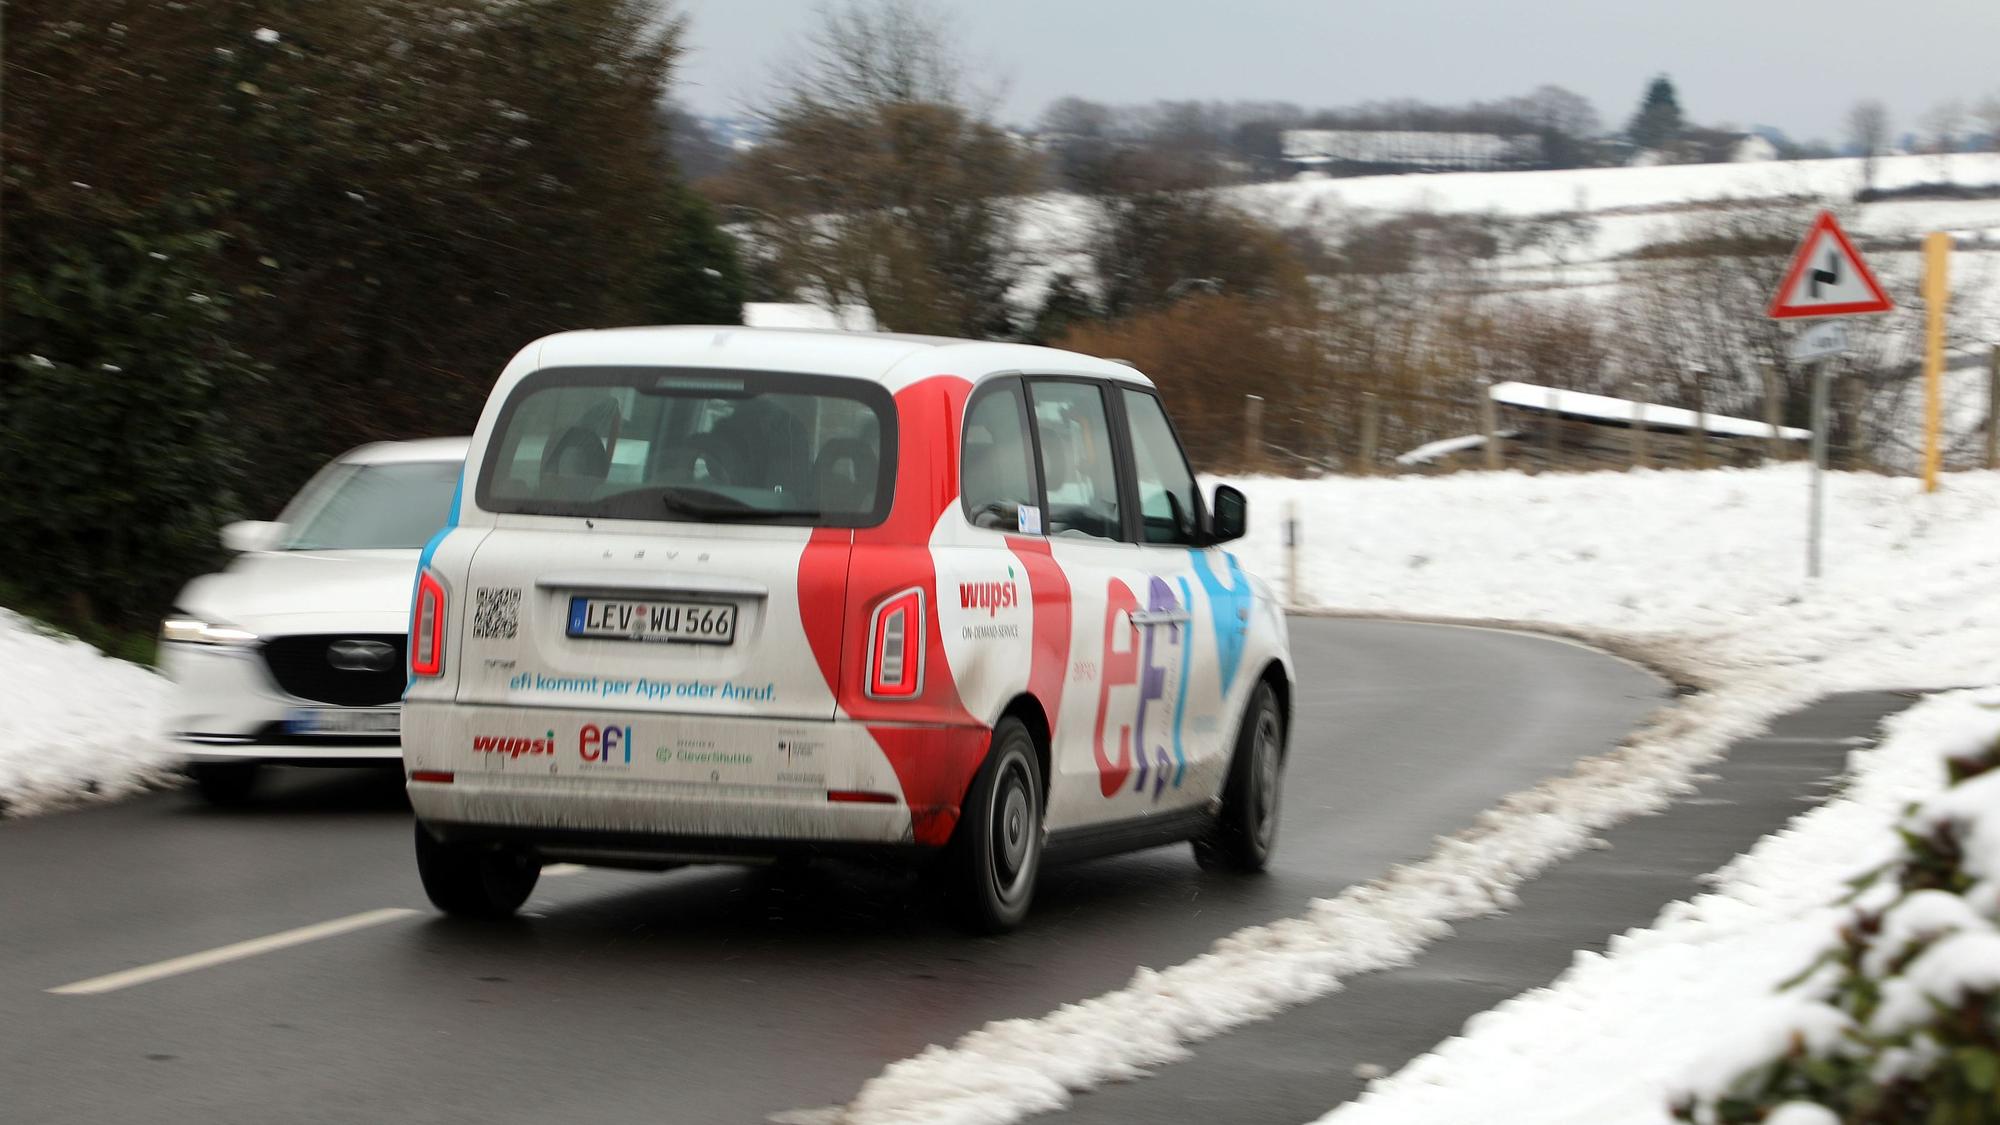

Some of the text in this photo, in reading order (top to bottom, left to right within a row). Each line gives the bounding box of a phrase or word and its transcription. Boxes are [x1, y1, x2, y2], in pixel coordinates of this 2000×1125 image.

[959, 565, 1018, 618] wupsi
[587, 604, 633, 631] LEV
[651, 606, 681, 633] WU
[685, 608, 729, 635] 566
[510, 672, 776, 702] efi kommt per App oder Anruf.
[473, 729, 555, 759] wupsi
